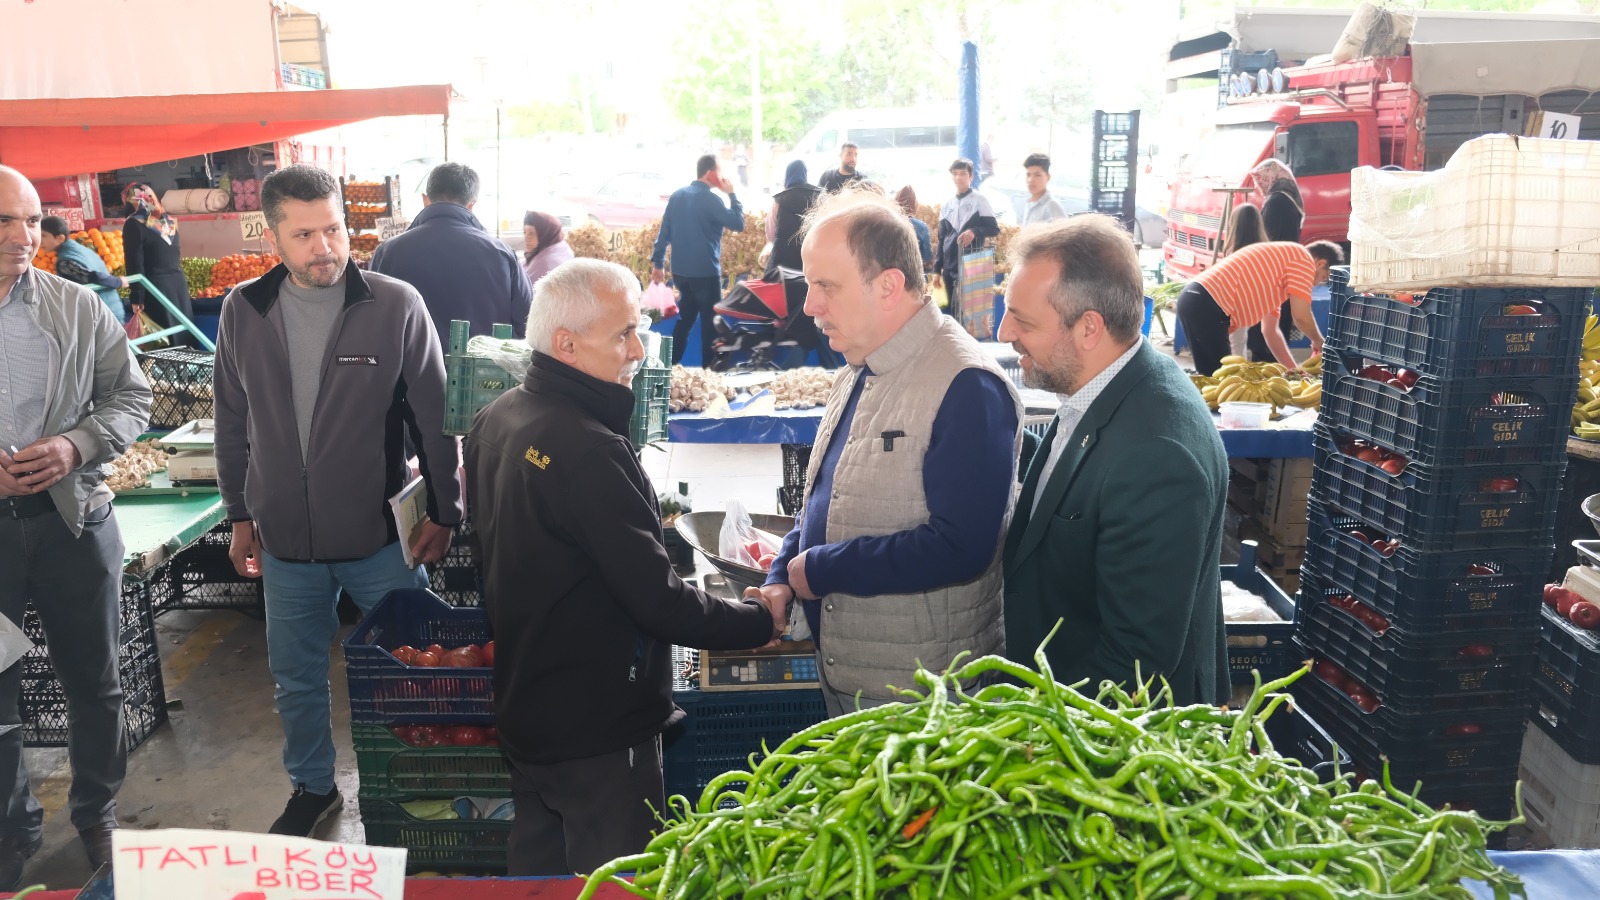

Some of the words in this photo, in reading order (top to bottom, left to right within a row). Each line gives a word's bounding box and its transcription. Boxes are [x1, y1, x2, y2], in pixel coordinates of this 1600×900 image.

[1550, 120, 1567, 139] 10
[245, 222, 263, 239] 20
[607, 231, 623, 252] 10
[119, 845, 257, 871] TATLI
[256, 867, 384, 900] BİBER
